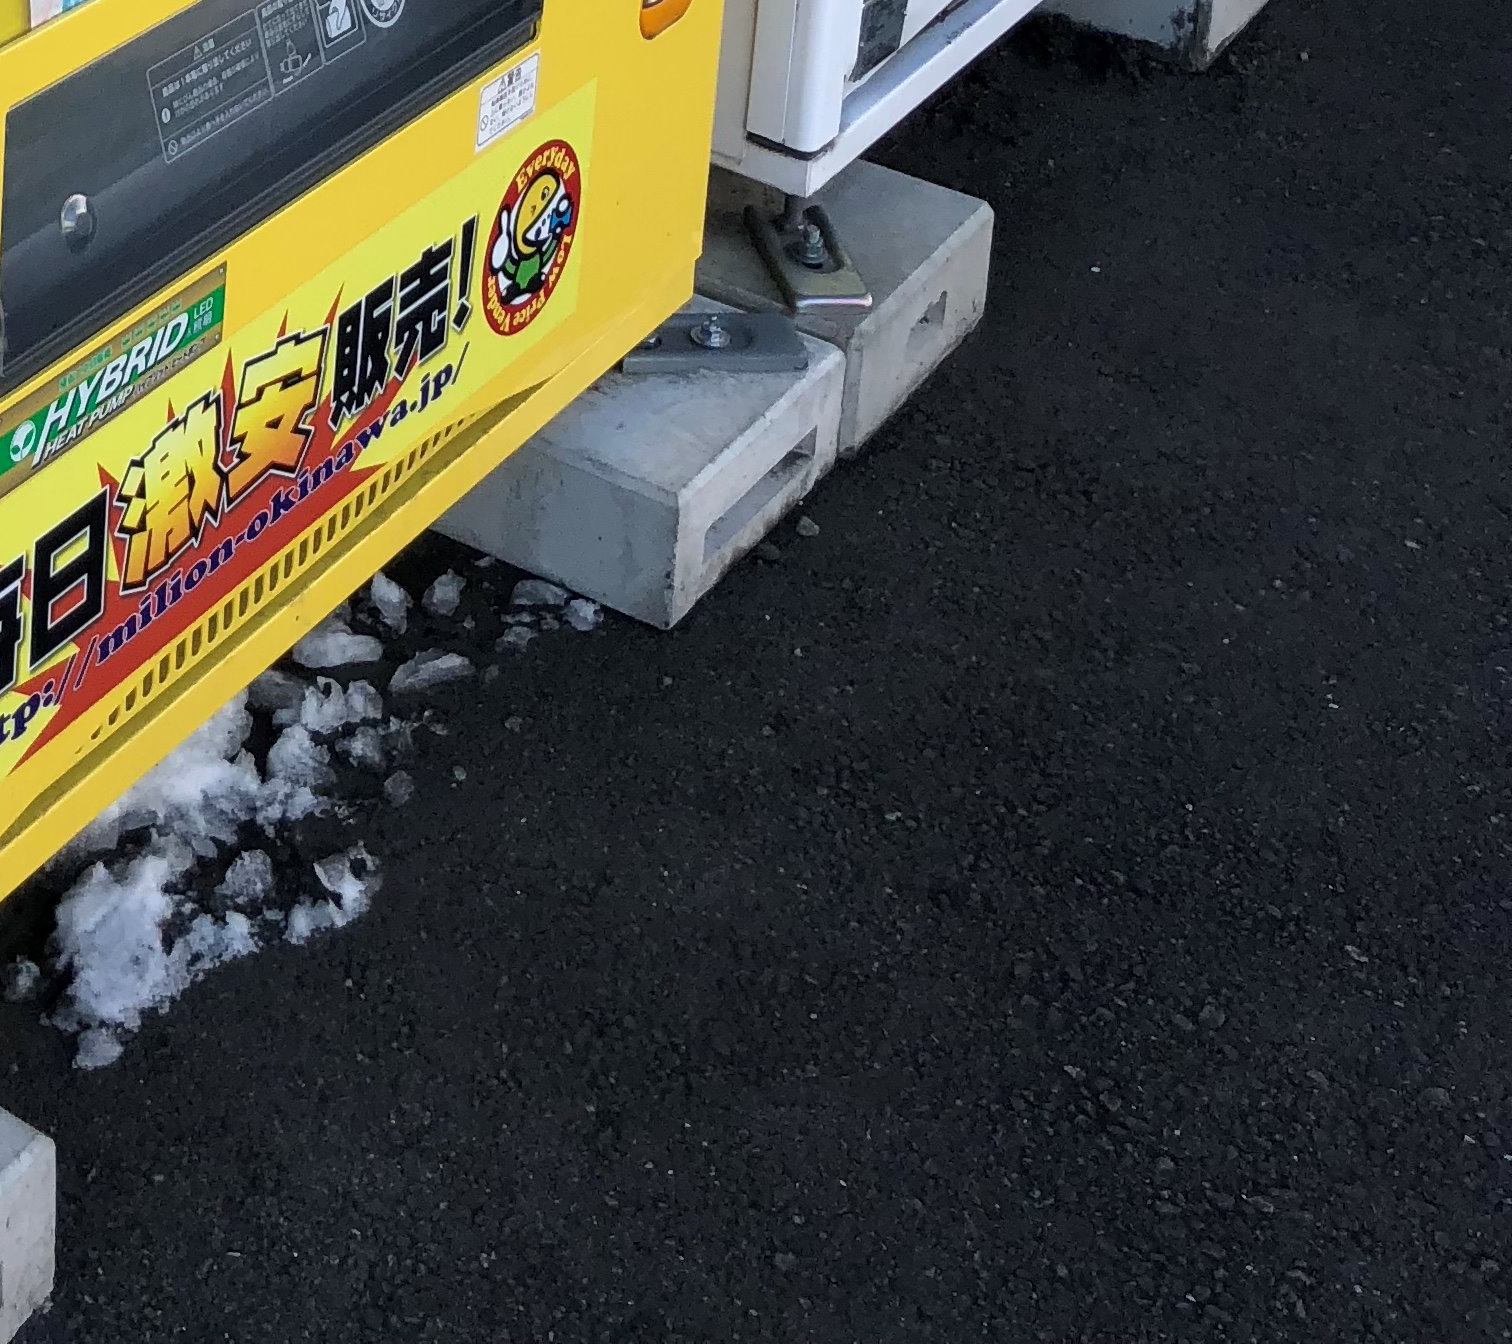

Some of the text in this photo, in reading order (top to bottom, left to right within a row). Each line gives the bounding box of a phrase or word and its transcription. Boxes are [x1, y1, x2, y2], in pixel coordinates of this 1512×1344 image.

[516, 146, 576, 194] Everyday
[548, 234, 573, 288] Low
[193, 296, 214, 320] LED
[513, 288, 547, 329] Price
[32, 312, 189, 470] HYBRID
[43, 383, 134, 462] HEAT PUMP
